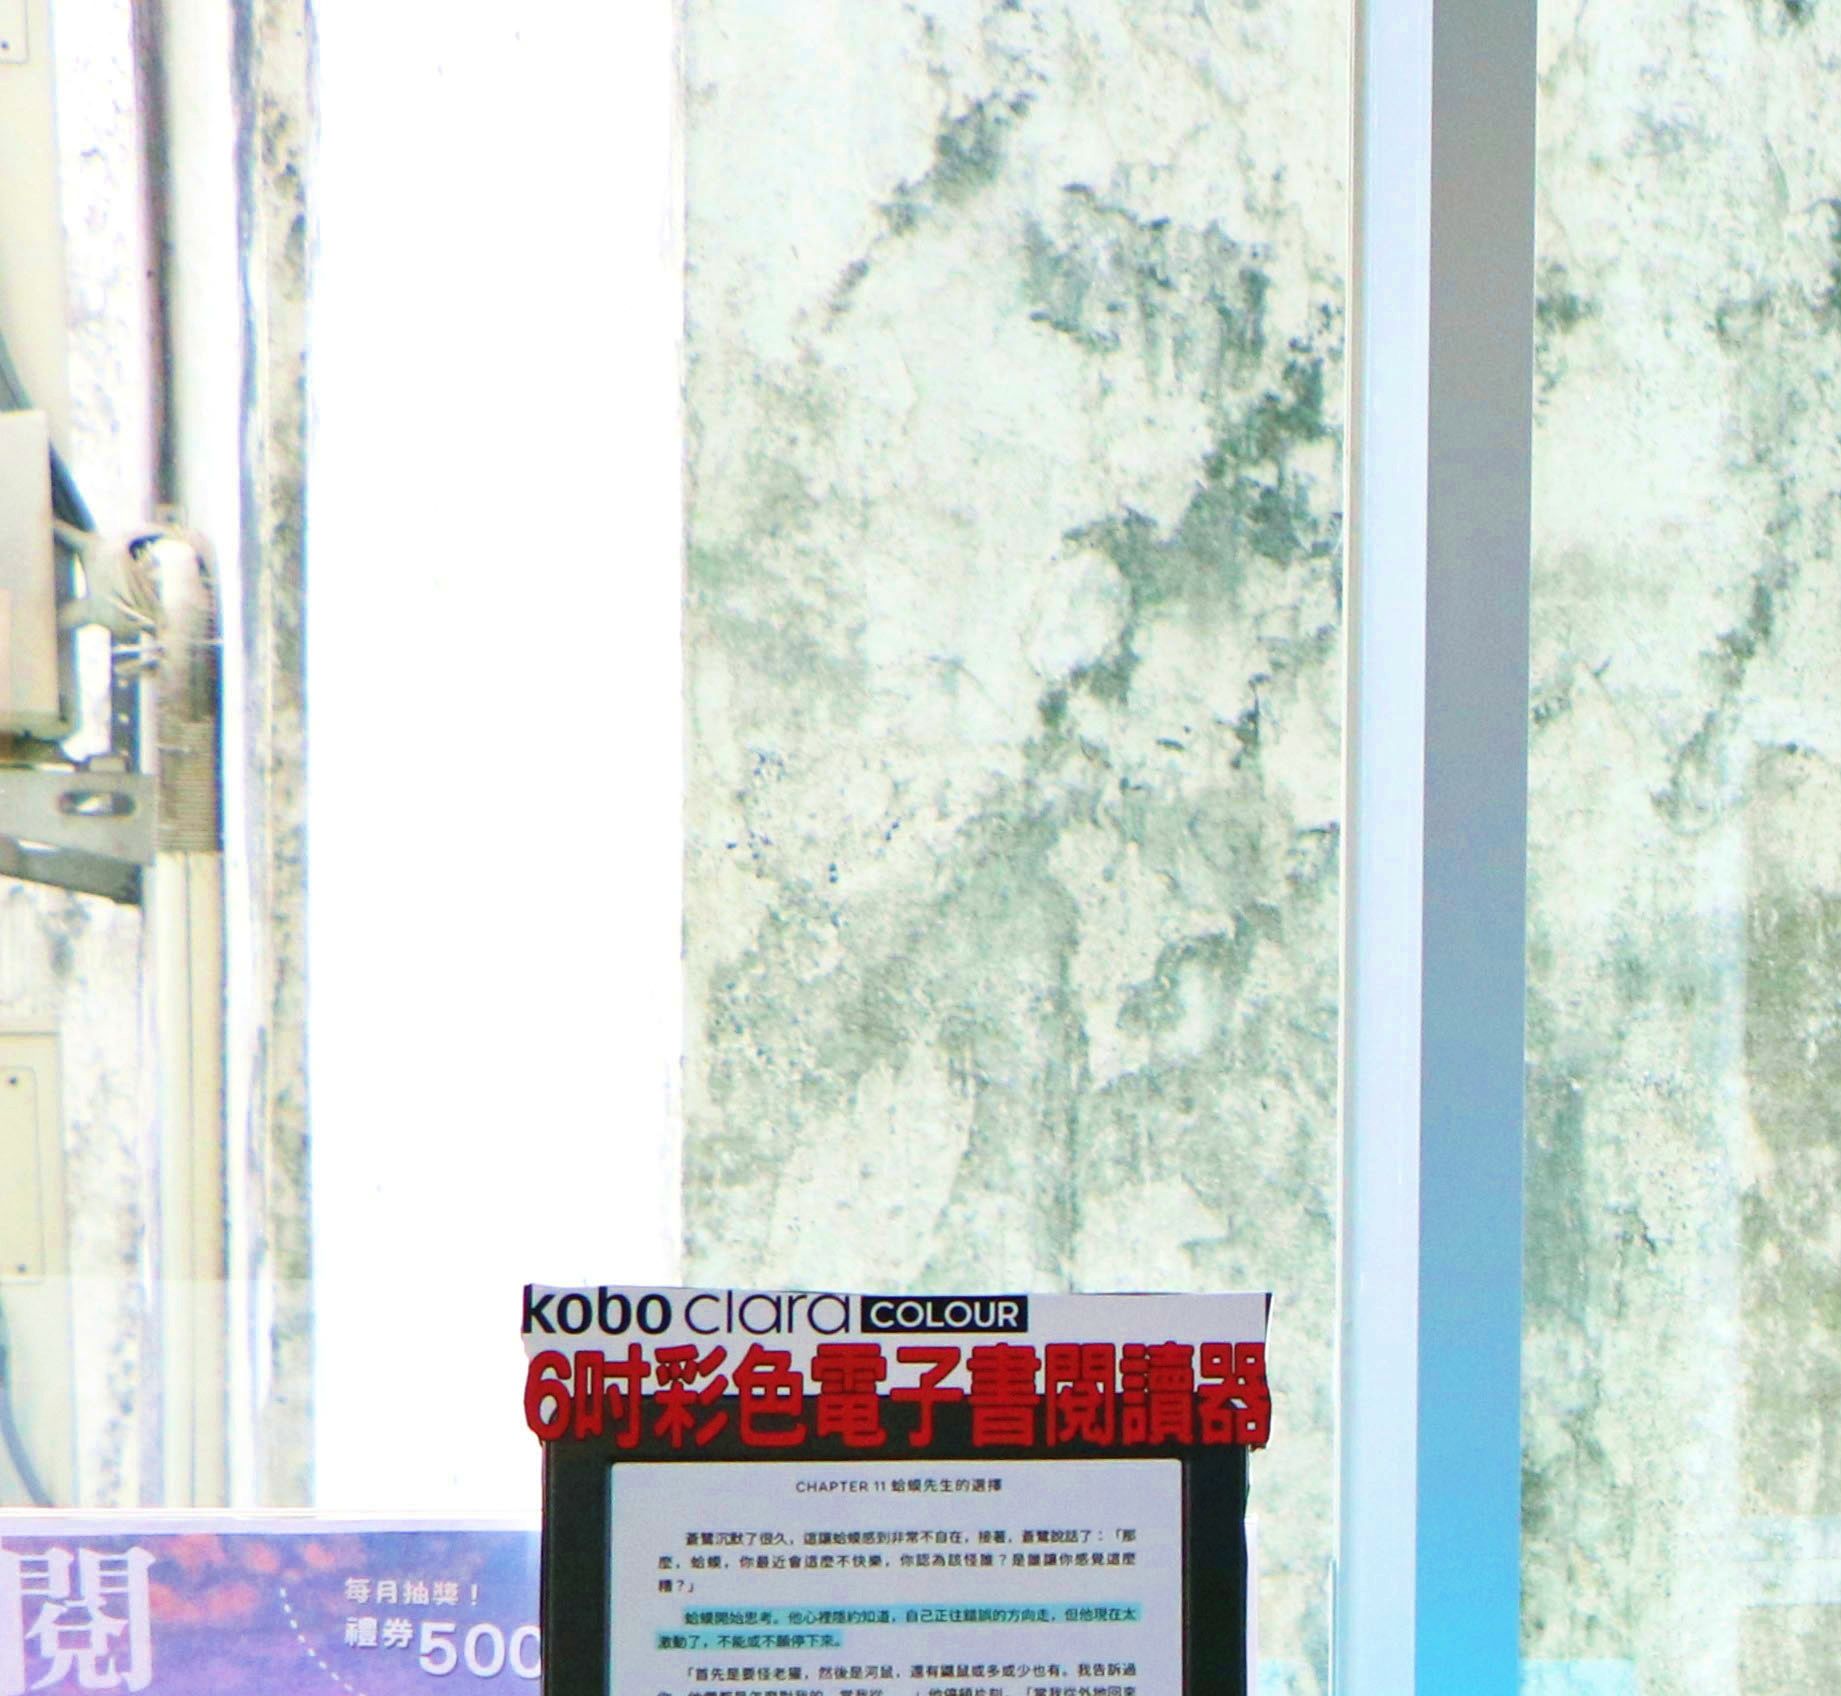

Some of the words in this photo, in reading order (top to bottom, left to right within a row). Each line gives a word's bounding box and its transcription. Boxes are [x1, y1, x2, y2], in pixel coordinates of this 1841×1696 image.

[522, 1284, 672, 1334] kobo
[684, 1290, 850, 1334] clara
[870, 1302, 1021, 1329] COLOUR
[525, 1342, 1271, 1449] 6吋彩色電子書閱讀器
[795, 1478, 869, 1493] CHAPTER
[873, 1479, 886, 1492] 11
[889, 1476, 1003, 1493] 蛤蟆先生的選擇
